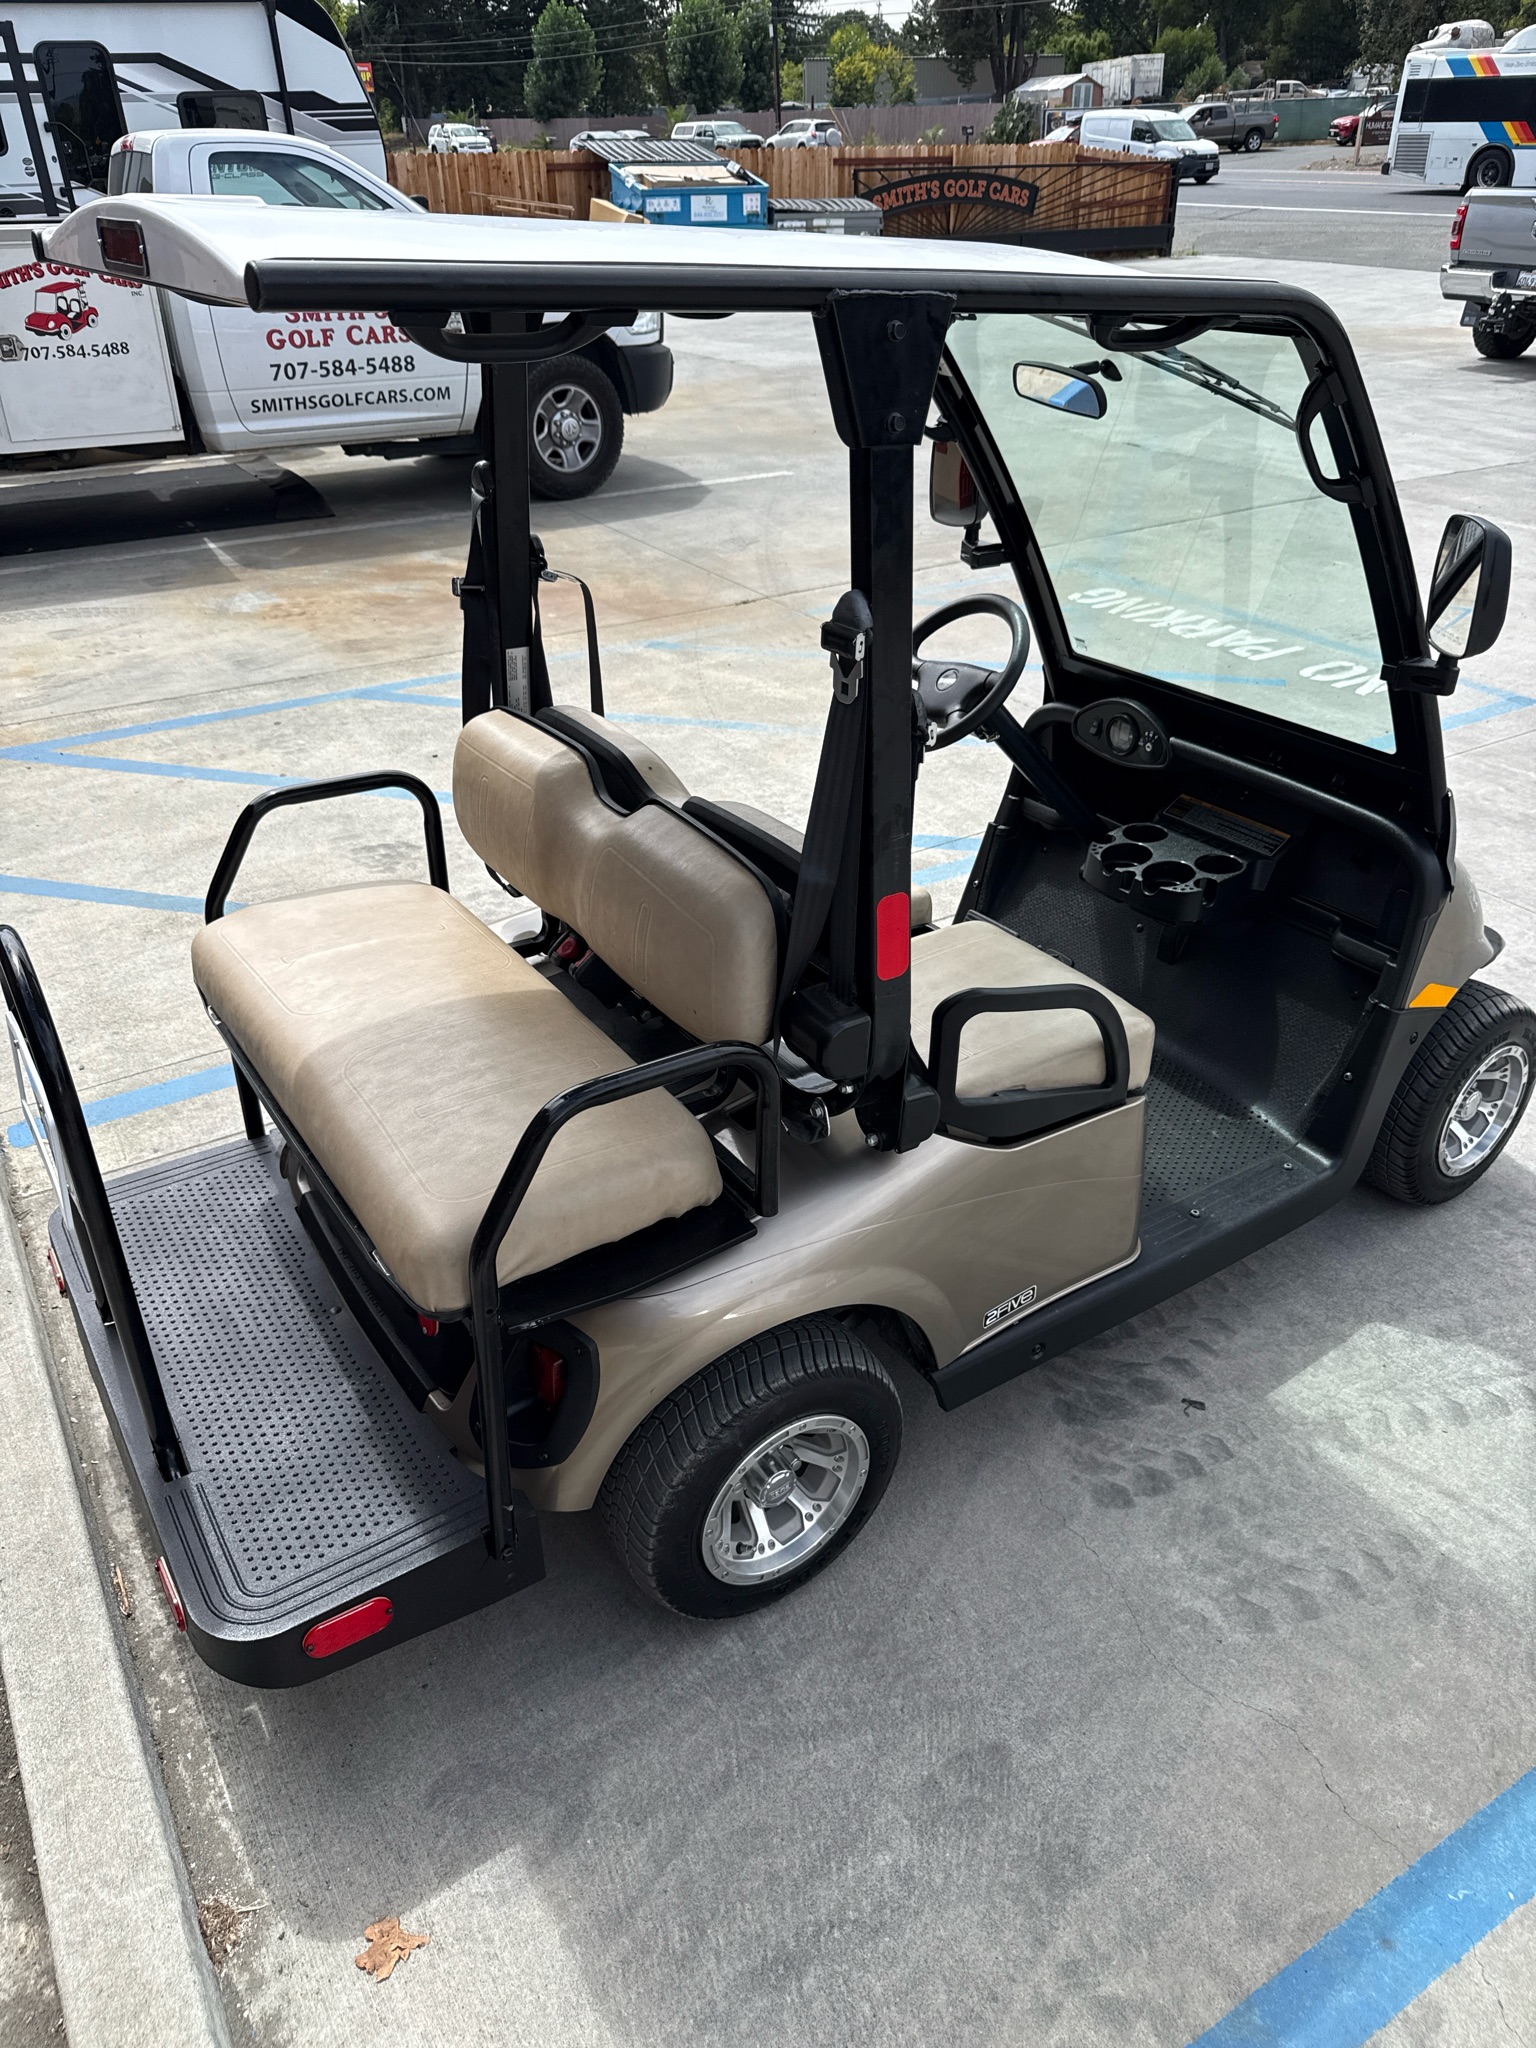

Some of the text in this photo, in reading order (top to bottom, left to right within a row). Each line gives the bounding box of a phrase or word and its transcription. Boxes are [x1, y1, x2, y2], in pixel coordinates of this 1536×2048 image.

[872, 178, 1030, 211] SMITH'S GOLF CARS
[266, 324, 411, 351] GOLF CARS
[23, 341, 130, 362] 707.584.5488
[269, 355, 416, 382] 707-584-5488
[250, 386, 451, 414] SMITHSGOLFCARS.COM
[1067, 587, 1305, 662] PARKING
